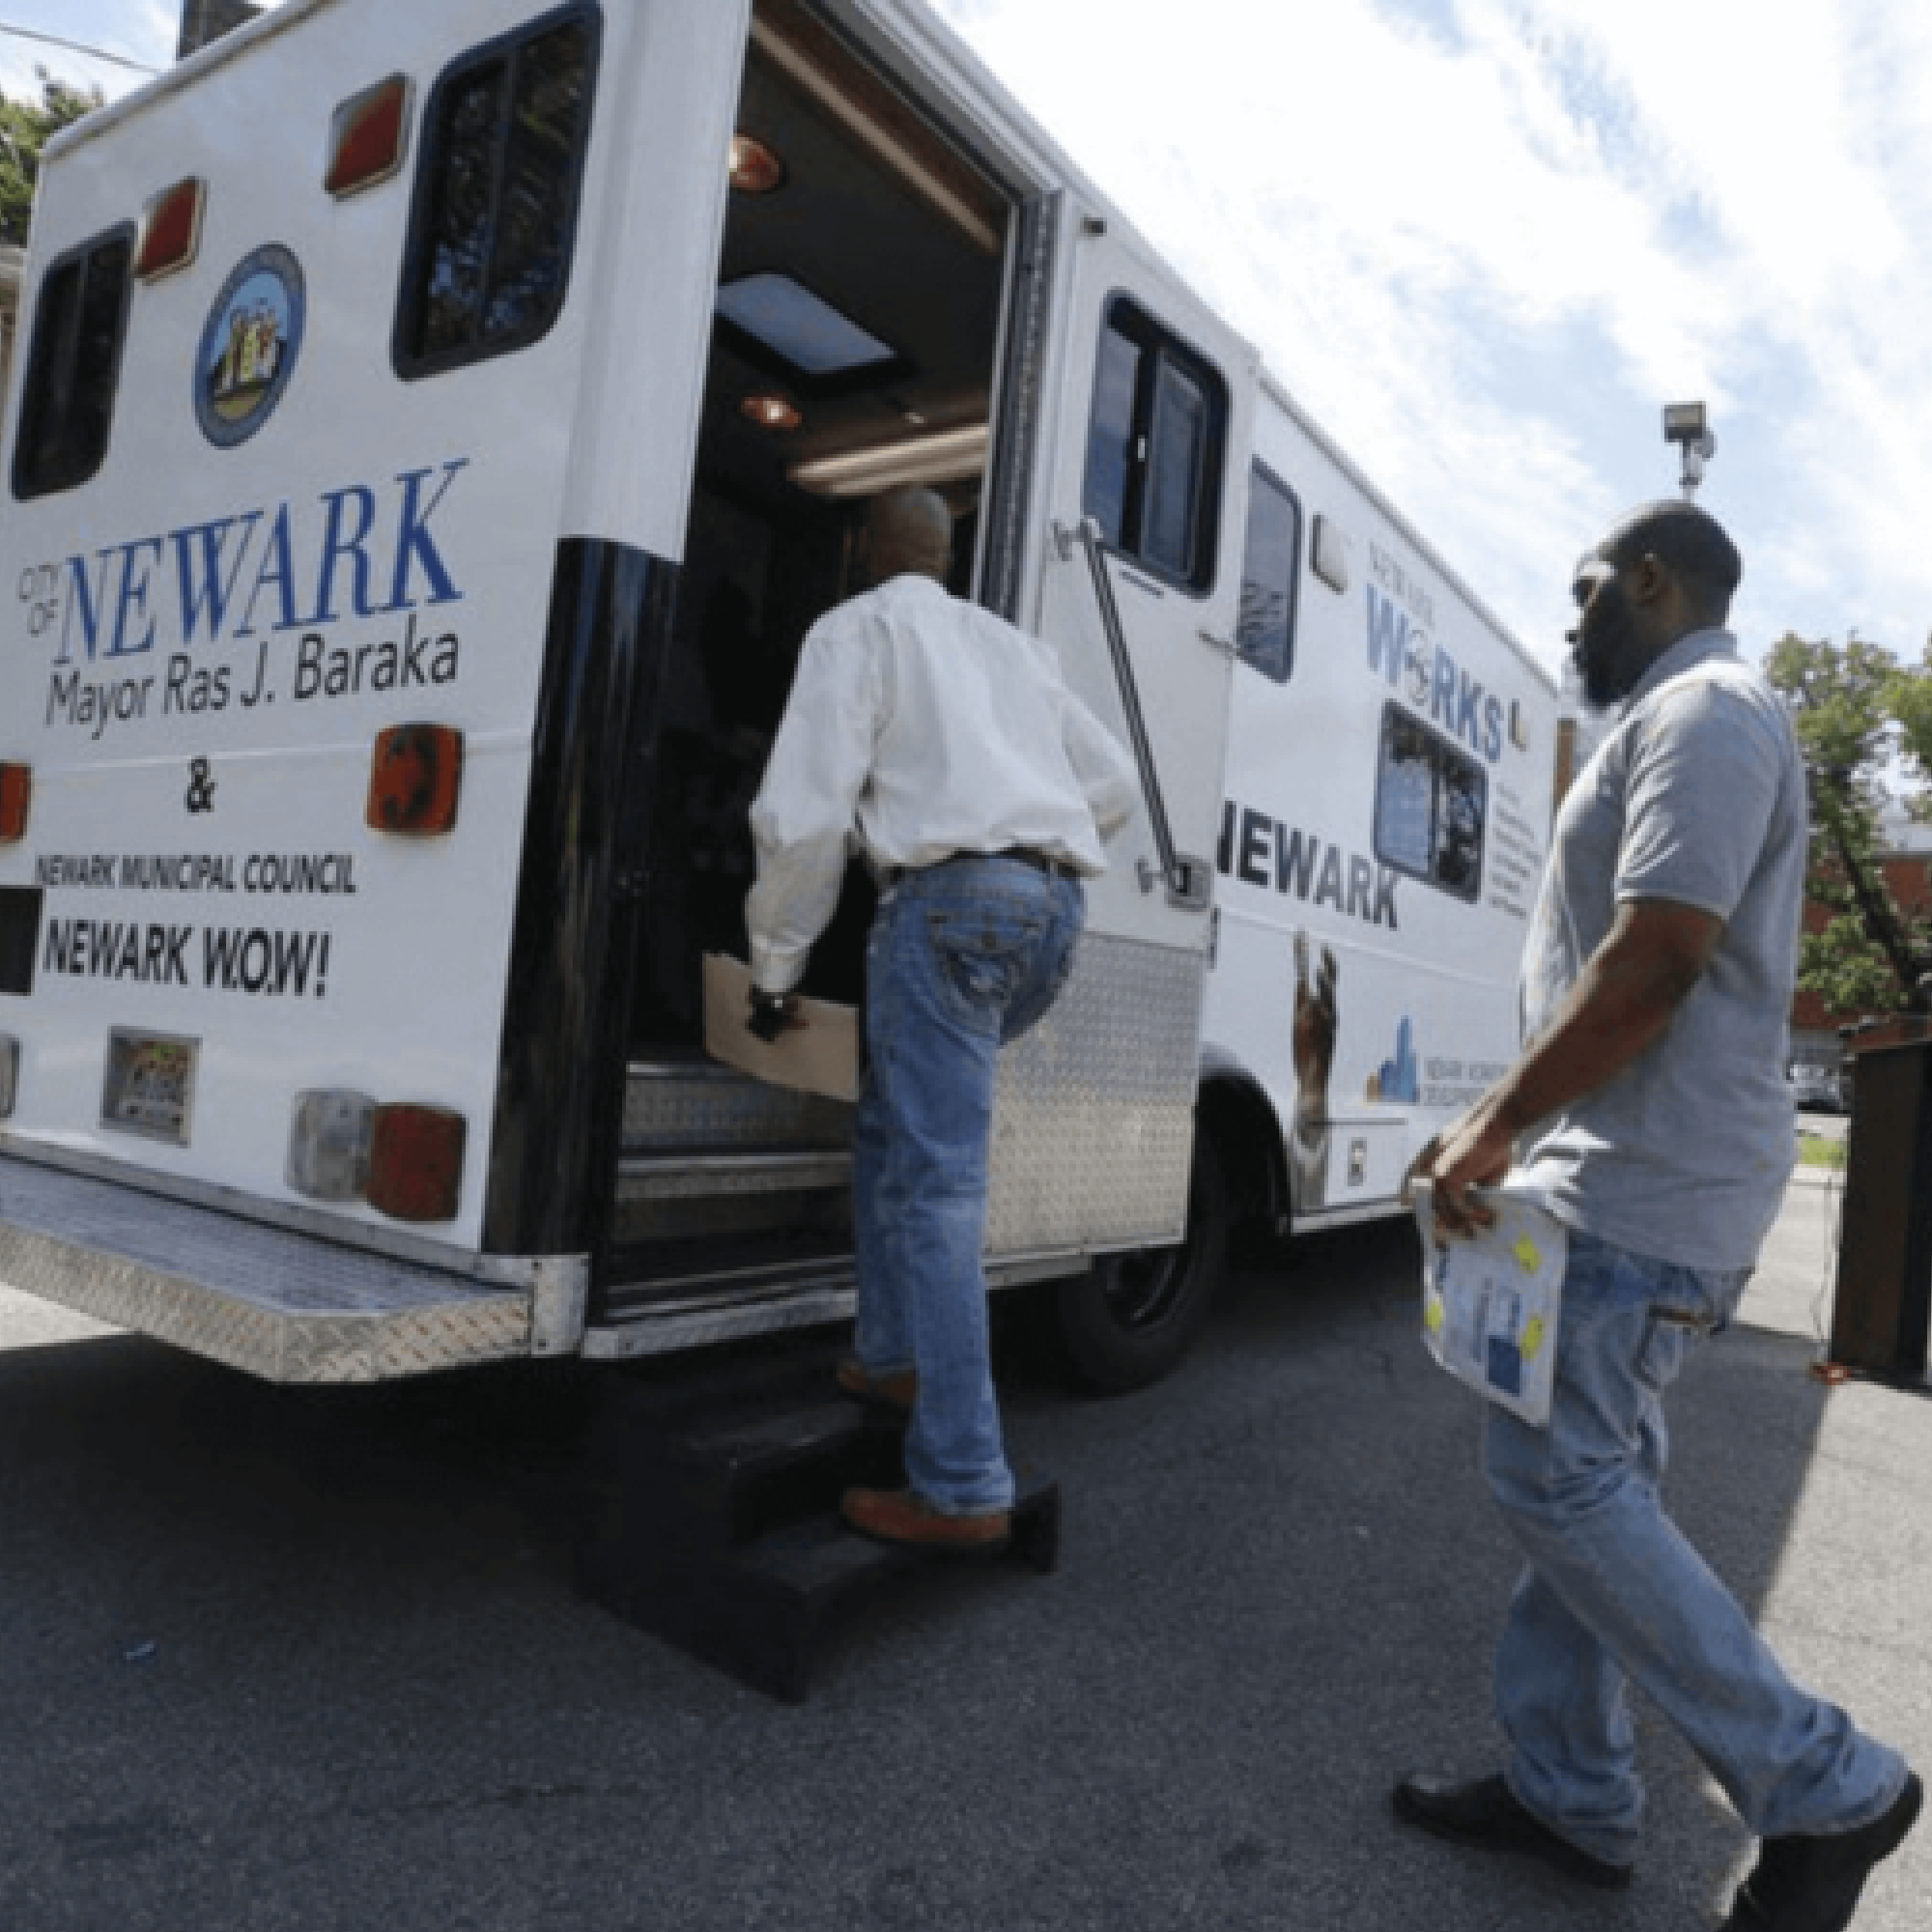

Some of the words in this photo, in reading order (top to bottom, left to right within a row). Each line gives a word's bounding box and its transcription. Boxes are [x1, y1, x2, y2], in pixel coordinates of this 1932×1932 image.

[53, 457, 469, 665] NEWARK
[43, 667, 154, 740] Mayor
[162, 652, 231, 714] Ras
[240, 640, 276, 707] J.
[294, 613, 459, 699] Baraka
[185, 757, 216, 814] &
[36, 854, 116, 887] NEWARK
[120, 854, 237, 893] MUNICIPAL
[242, 854, 357, 894] COUNCIL
[43, 917, 194, 986] NEWARK
